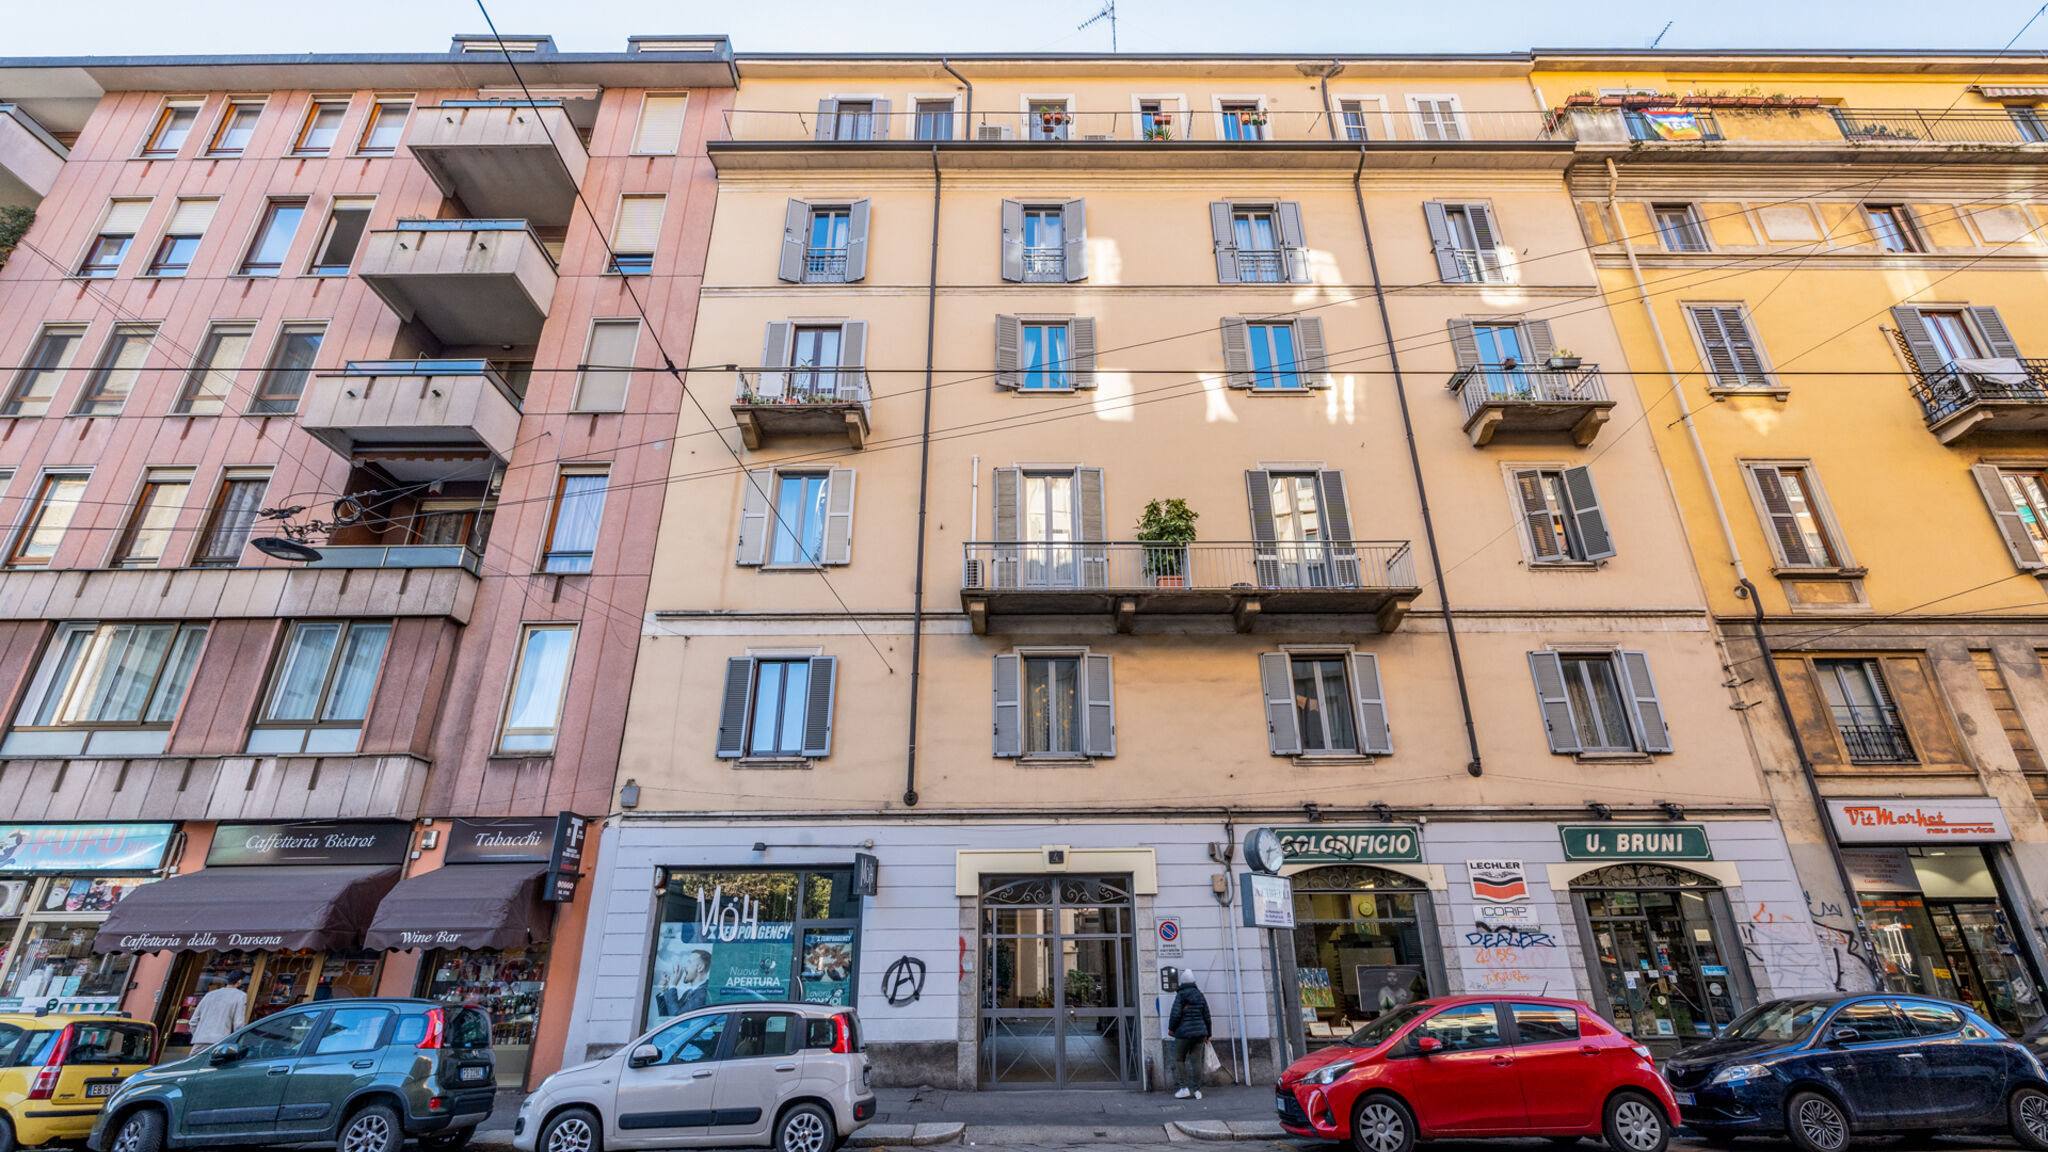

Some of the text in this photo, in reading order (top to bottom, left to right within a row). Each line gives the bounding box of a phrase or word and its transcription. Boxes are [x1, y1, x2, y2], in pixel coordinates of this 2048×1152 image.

[29, 828, 128, 855] FUFU
[245, 832, 376, 853] Caffetteria Bistrot
[475, 831, 542, 847] Tabacchi
[1280, 834, 1411, 854] COLORIFICIO
[1586, 833, 1682, 852] U. BRUNI
[1481, 907, 1527, 916] ICORIP
[120, 932, 282, 950] Caffetteria della Darsena
[400, 931, 461, 943] Wine Bar
[730, 966, 759, 976] Nuova
[725, 977, 781, 987] APERTURA
